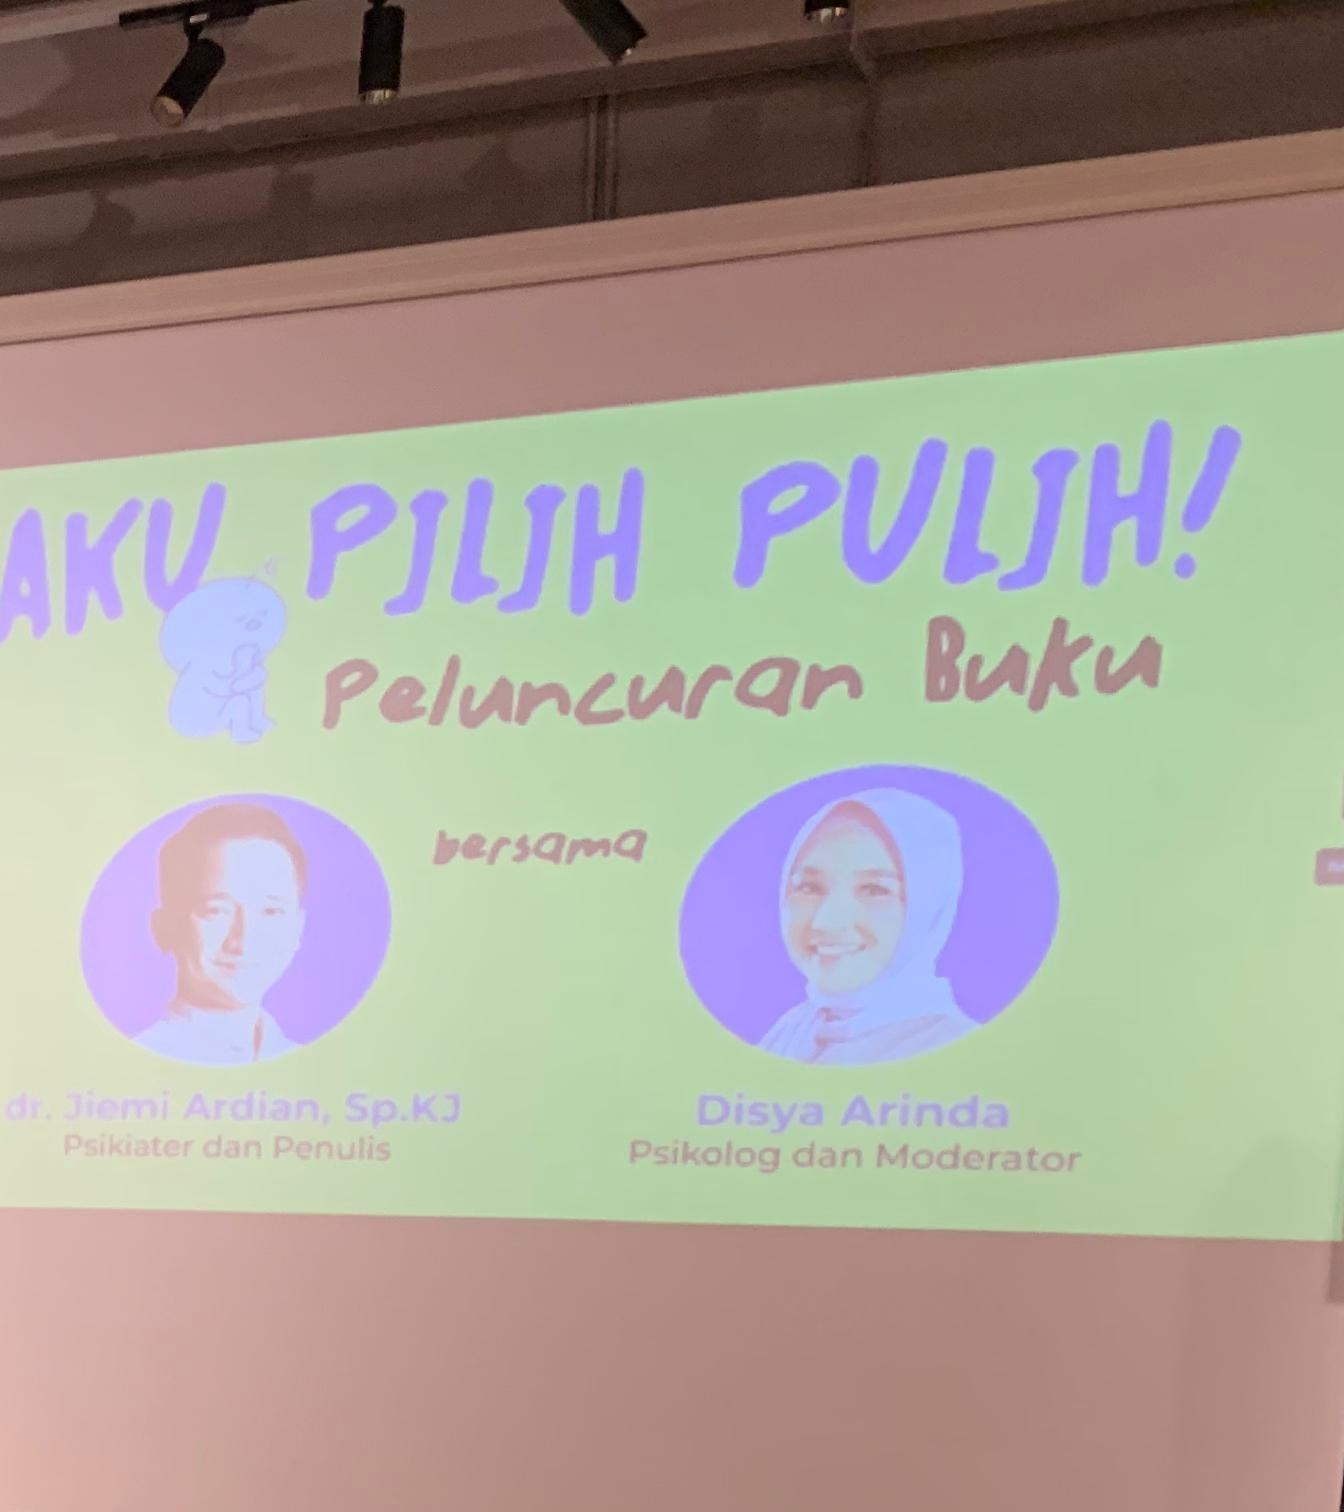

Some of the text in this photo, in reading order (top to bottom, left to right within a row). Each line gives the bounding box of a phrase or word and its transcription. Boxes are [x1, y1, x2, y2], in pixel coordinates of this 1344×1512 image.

[322, 615, 1163, 729] Peluncuran Buku
[433, 829, 647, 865] bersama
[3, 1090, 462, 1128] dr. Jiemi Ardian, Sp.KJ
[696, 1093, 1010, 1133] Disya Arinda
[63, 1133, 391, 1162] Psikiater dan Penulis
[628, 1140, 1082, 1174] Psikolog dan Moderator
